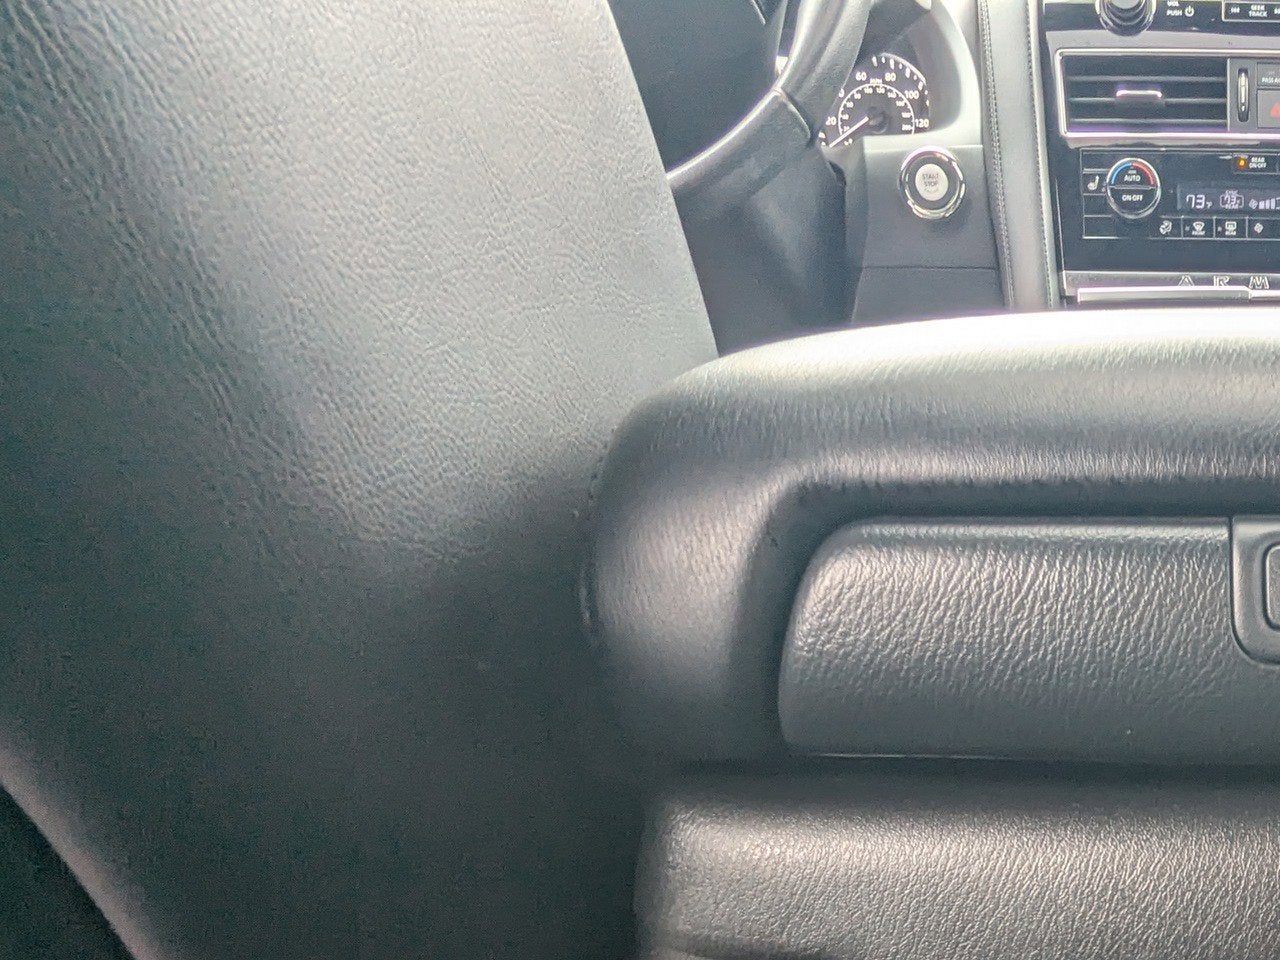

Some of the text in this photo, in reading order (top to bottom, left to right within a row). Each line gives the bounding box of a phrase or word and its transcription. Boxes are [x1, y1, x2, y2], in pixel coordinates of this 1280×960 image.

[855, 71, 867, 81] 60
[884, 72, 897, 82] 80
[904, 90, 920, 100] 100
[915, 118, 930, 128] 120
[1124, 174, 1141, 182] AUTO
[1186, 194, 1206, 209] 73
